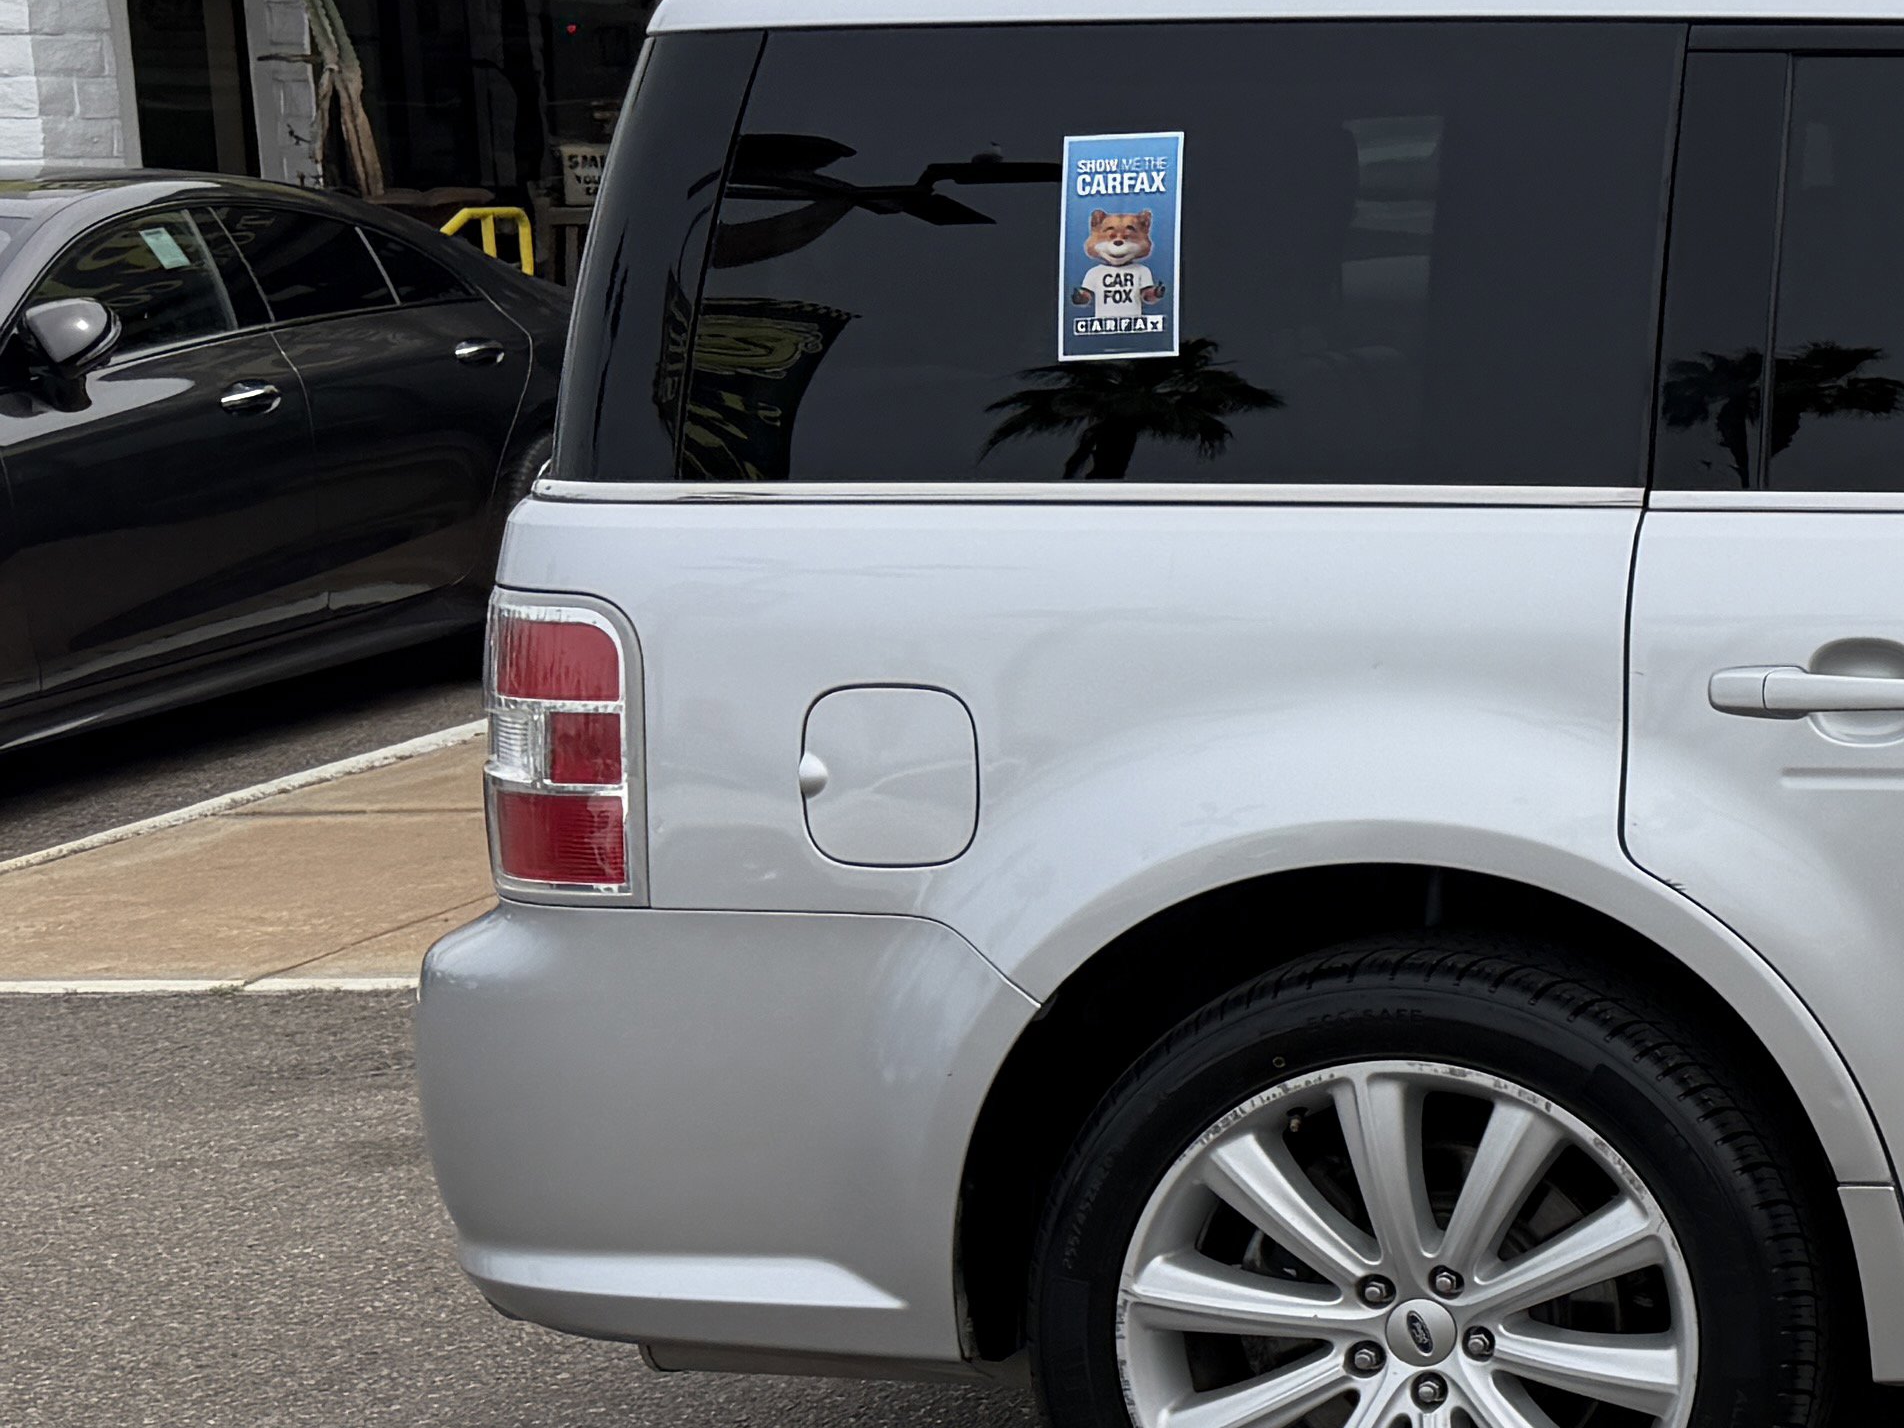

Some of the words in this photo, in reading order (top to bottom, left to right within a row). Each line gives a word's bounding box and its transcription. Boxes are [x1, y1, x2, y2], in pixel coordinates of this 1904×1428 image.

[1076, 159, 1118, 173] SHOW
[1123, 157, 1142, 171] ME
[1144, 156, 1168, 170] THE
[1076, 172, 1167, 196] CARFAX
[1102, 273, 1135, 288] CAR
[1103, 289, 1133, 305] FOX
[1075, 316, 1163, 334] CARFAX
